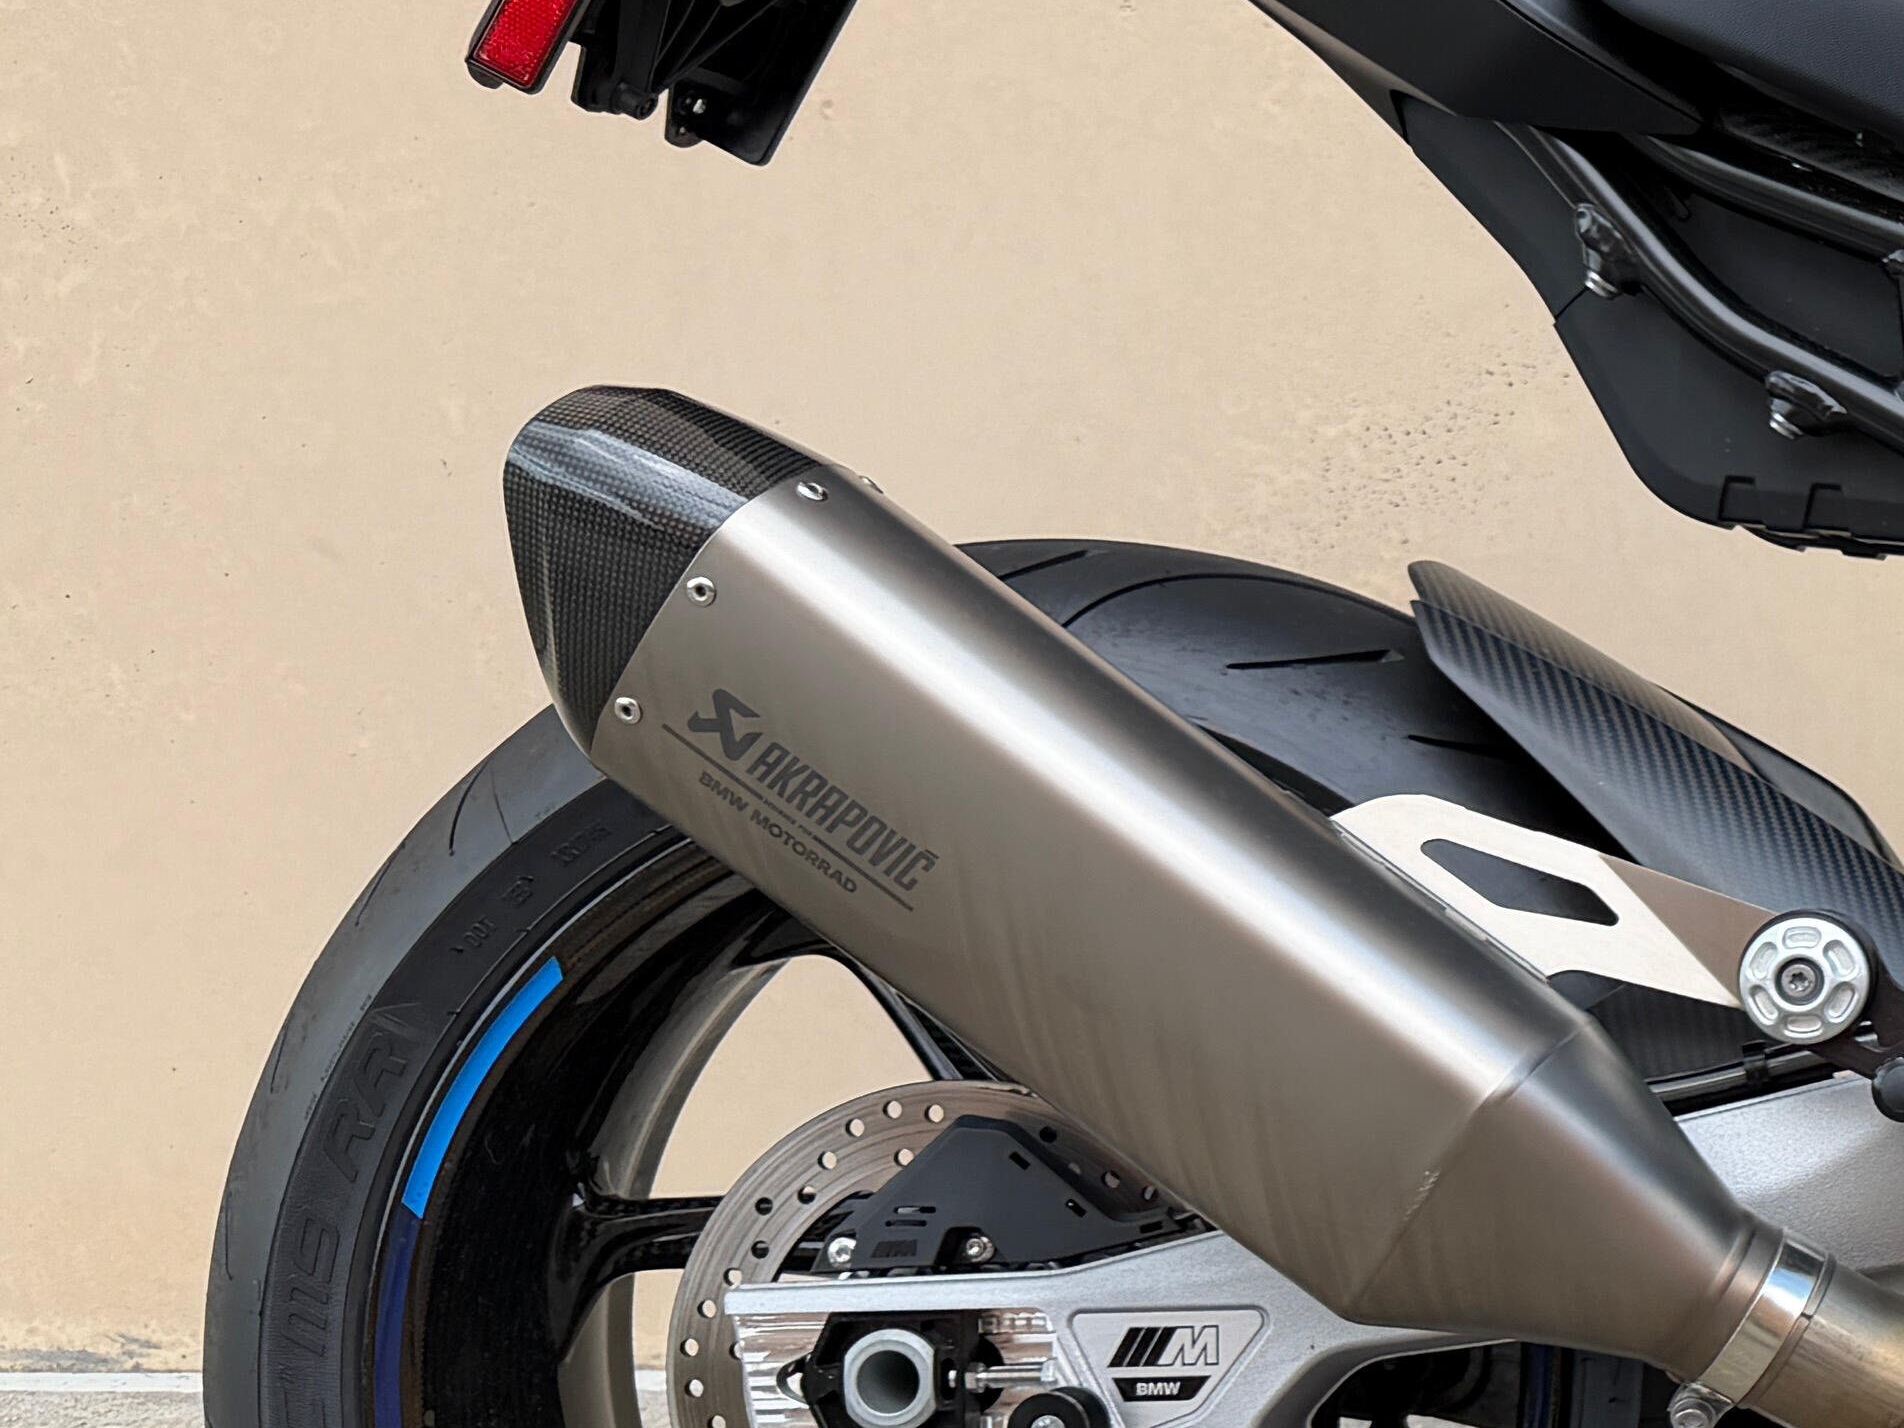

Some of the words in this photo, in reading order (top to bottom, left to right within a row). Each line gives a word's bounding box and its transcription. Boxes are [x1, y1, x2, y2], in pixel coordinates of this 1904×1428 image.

[699, 772, 749, 813] BMW
[750, 809, 857, 893] MOTORRAD
[1135, 1381, 1181, 1396] BMW
